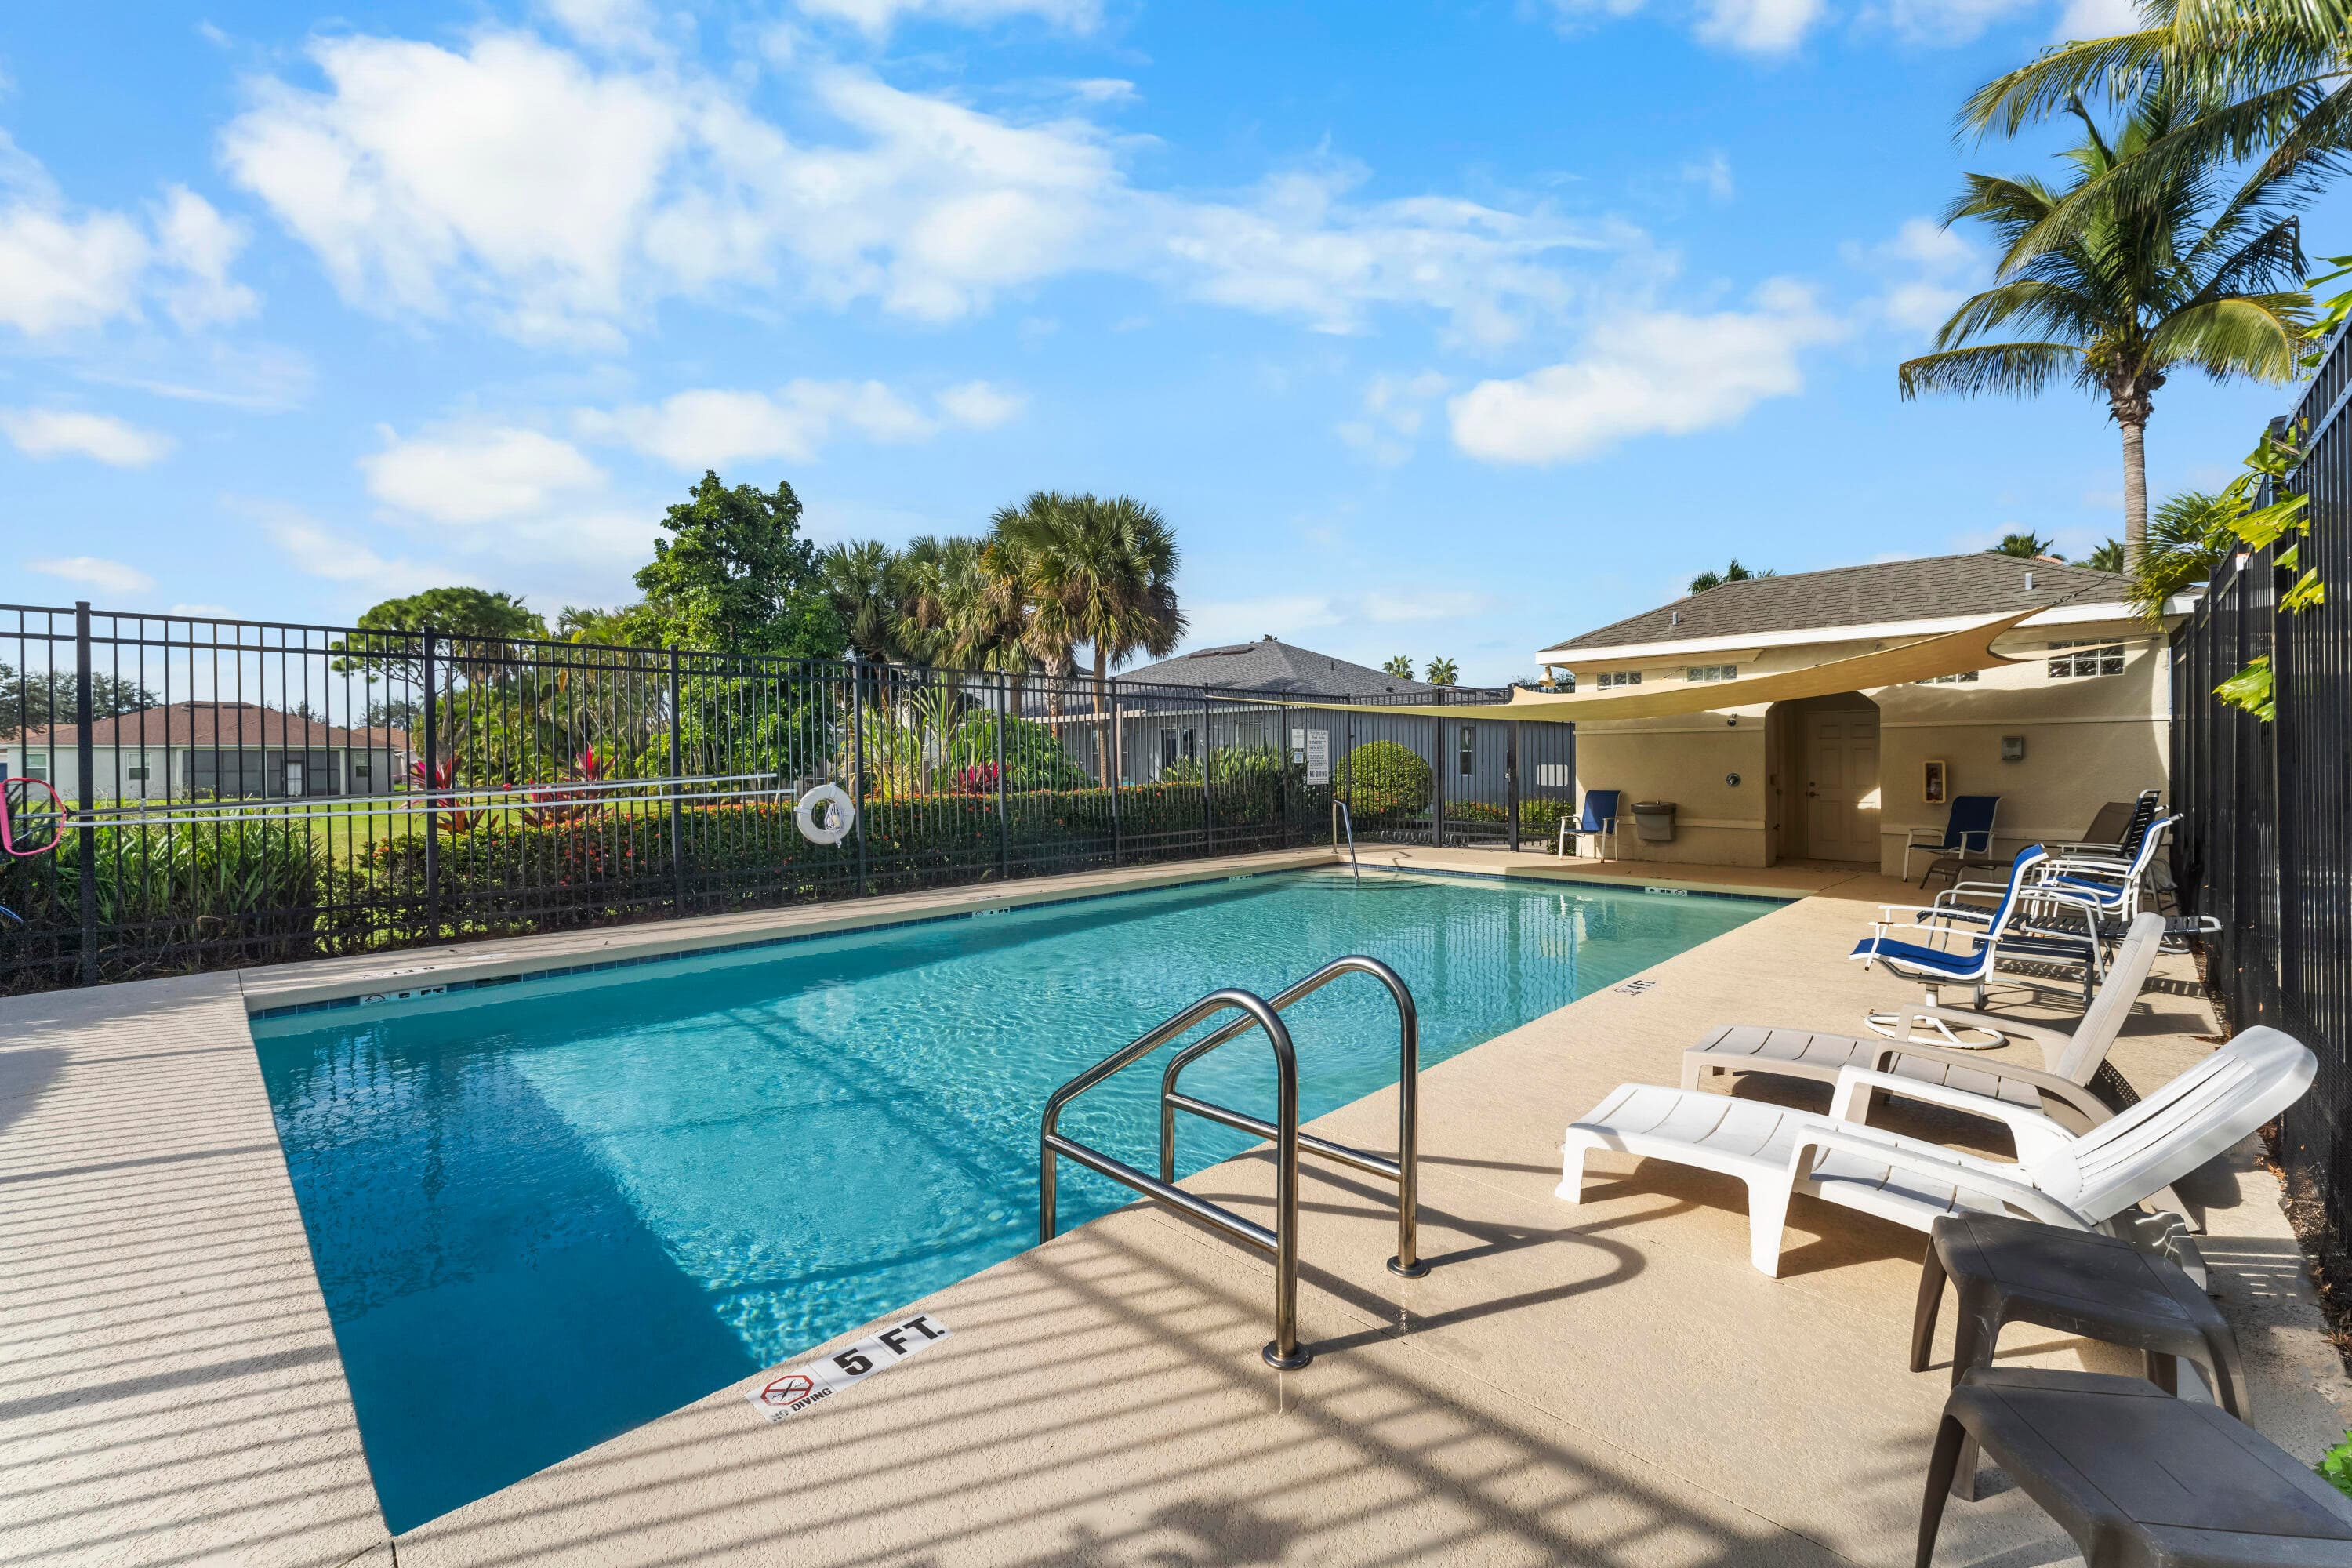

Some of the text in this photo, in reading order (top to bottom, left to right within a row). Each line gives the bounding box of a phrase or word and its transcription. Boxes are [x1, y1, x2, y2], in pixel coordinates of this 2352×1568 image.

[832, 1316, 946, 1376] 5 FT.
[789, 1388, 833, 1412] DIVING
